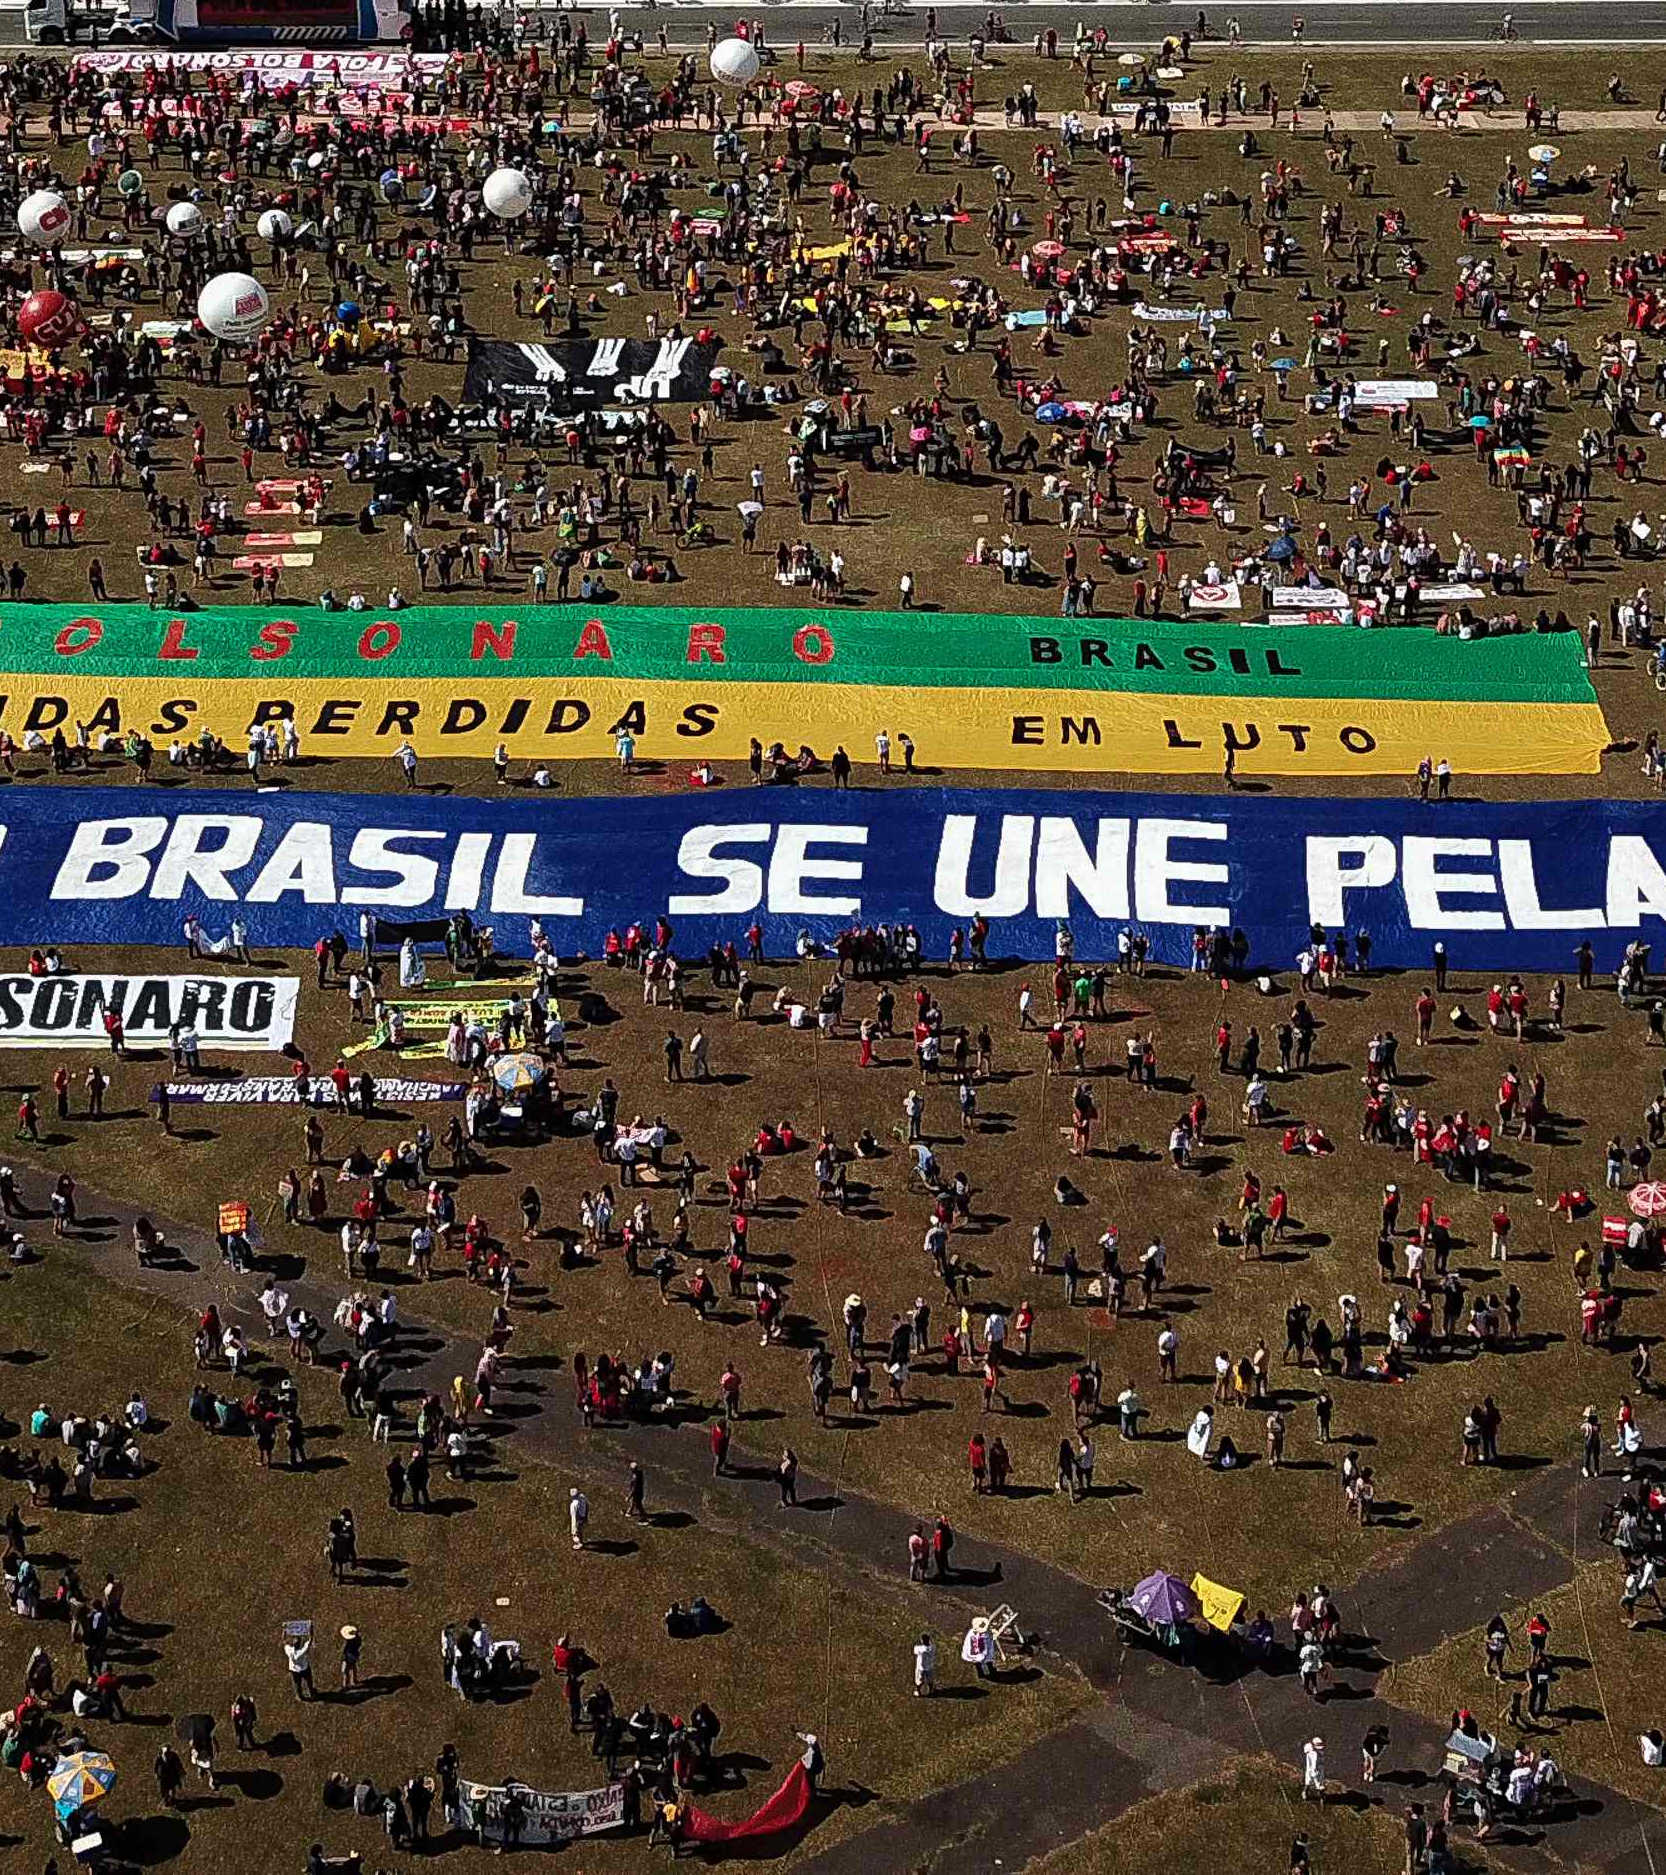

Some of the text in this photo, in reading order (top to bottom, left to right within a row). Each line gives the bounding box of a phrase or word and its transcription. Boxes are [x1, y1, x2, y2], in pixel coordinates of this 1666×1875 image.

[1028, 636, 1302, 677] BRASIL
[244, 698, 719, 738] PERDIDAS
[1011, 715, 1377, 756] EM LUTO
[49, 814, 584, 917] BRASIL
[668, 823, 869, 916] SE
[933, 814, 1230, 926] UNE
